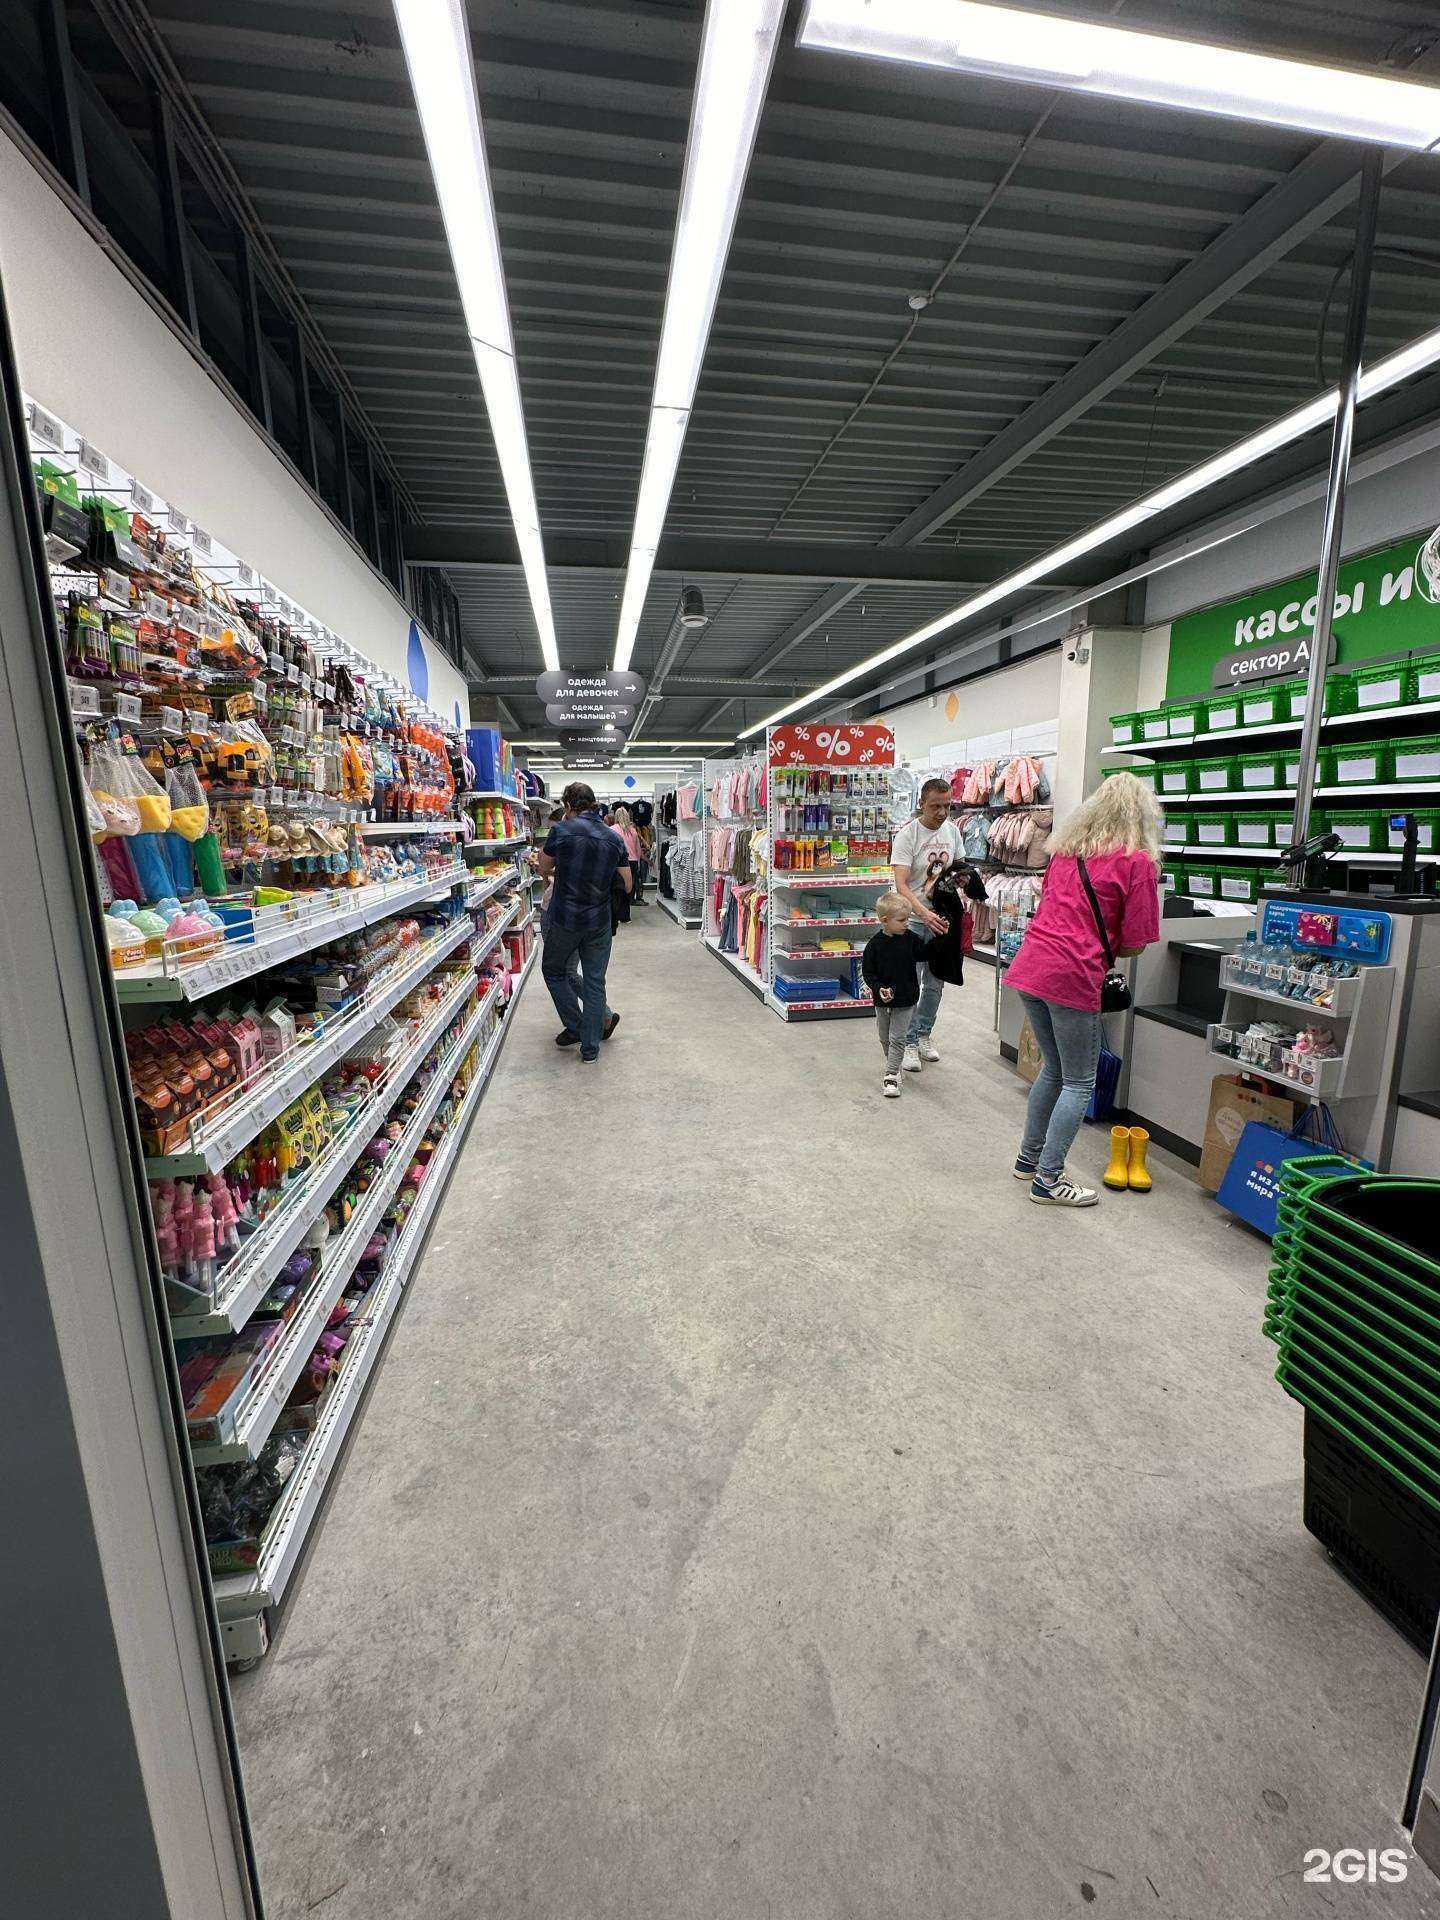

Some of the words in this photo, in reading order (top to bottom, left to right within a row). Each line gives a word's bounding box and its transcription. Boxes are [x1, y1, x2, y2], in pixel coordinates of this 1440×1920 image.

[1234, 581, 1365, 647] кассы
[1379, 566, 1414, 606] и
[1230, 651, 1290, 676] сектор
[1293, 640, 1310, 663] А
[567, 678, 607, 687] одежда
[555, 689, 575, 698] для
[576, 689, 619, 698] девочек
[571, 704, 604, 712] одежда
[559, 713, 576, 721] для
[576, 711, 617, 720] малышей
[1246, 1179, 1274, 1199] мира
